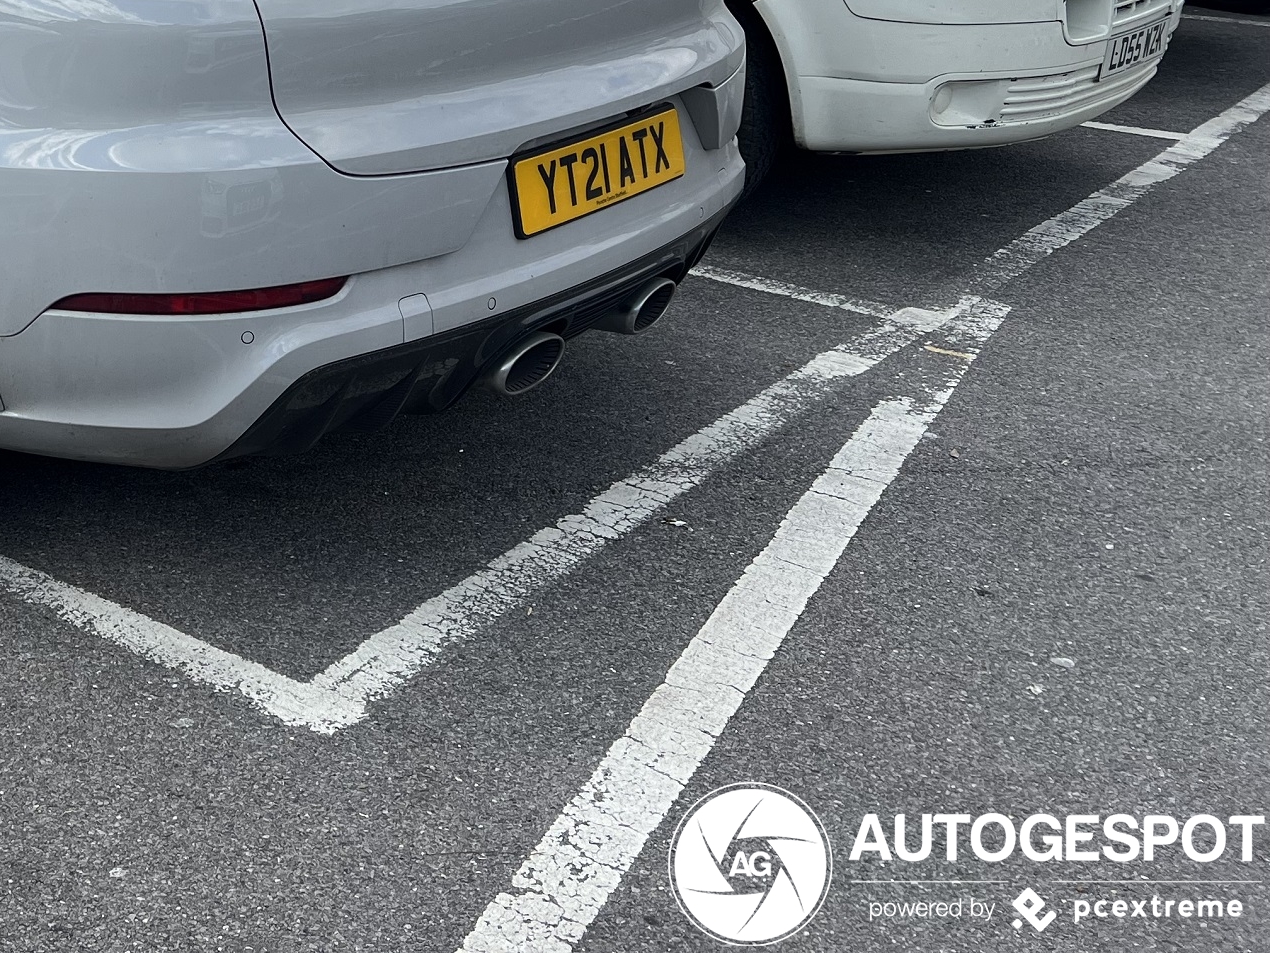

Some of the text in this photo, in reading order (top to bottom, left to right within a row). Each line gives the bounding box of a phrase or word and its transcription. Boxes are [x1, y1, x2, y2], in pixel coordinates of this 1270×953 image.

[1109, 31, 1145, 71] LD55
[537, 121, 670, 215] YT21 ATX
